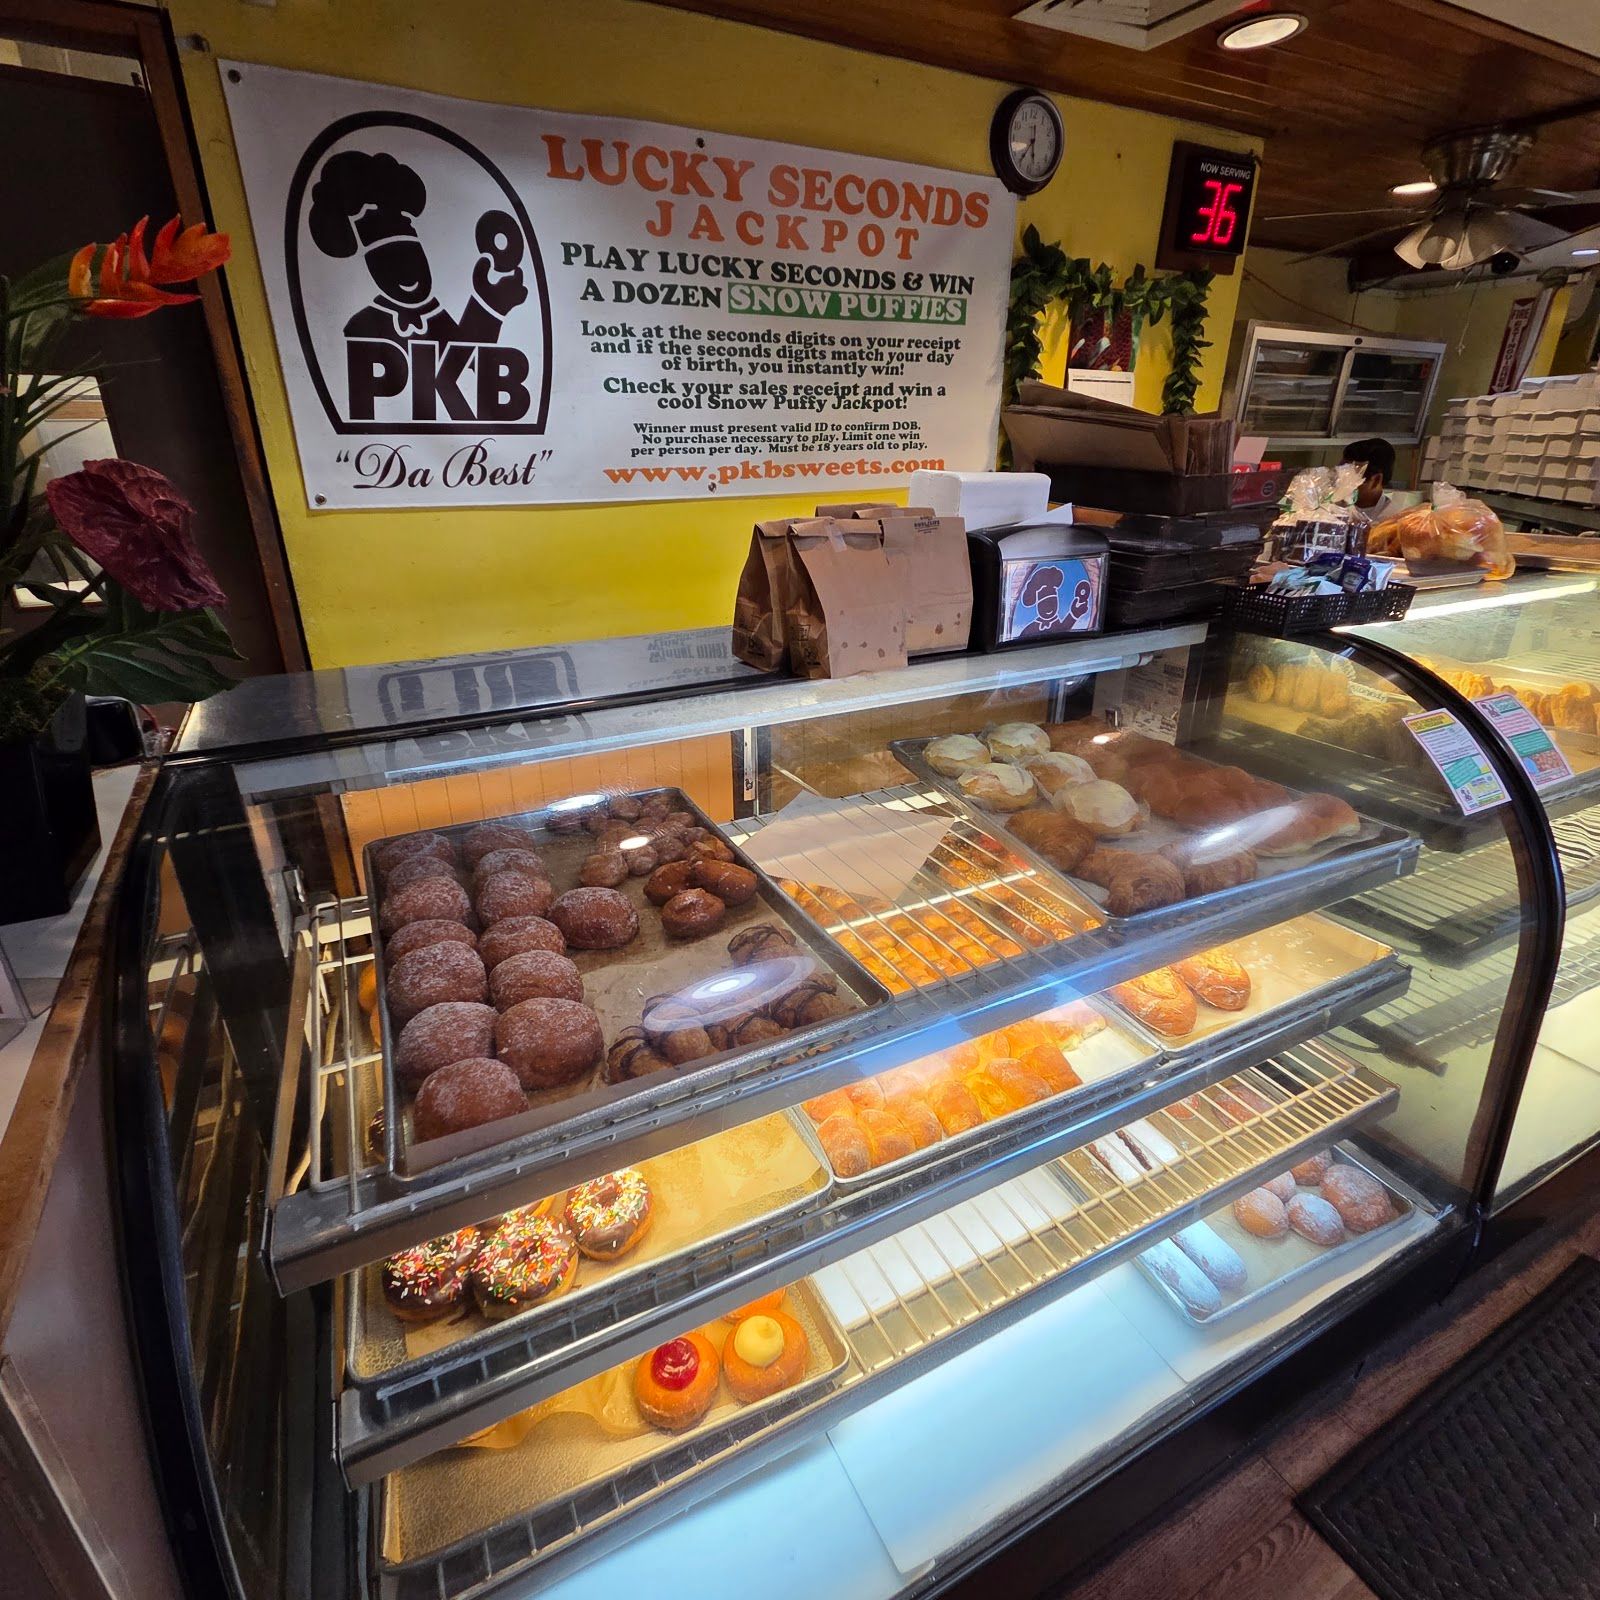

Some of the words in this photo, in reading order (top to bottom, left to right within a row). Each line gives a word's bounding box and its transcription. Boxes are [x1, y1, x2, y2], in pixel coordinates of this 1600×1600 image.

[541, 134, 755, 202] LUCKY
[767, 164, 991, 229] SECONDS
[1200, 162, 1219, 174] NOW
[1219, 166, 1252, 180] SERVING
[1191, 180, 1243, 245] 36
[645, 200, 919, 260] JACKPOT
[560, 242, 649, 272] PLAY
[657, 251, 764, 280] LUCKY
[770, 261, 896, 291] SECONDS
[902, 271, 924, 291] &
[929, 273, 975, 295] WIN
[580, 278, 605, 302] A
[612, 280, 723, 309] DOZEN
[729, 283, 831, 317] SNOW
[838, 293, 963, 323] PUFFIES
[580, 320, 637, 338] Look
[641, 324, 664, 339] at
[669, 324, 702, 340] the
[706, 329, 781, 344] seconds
[785, 330, 836, 349] digits
[840, 336, 862, 347] on
[866, 336, 904, 350] your
[907, 336, 961, 352] receipt
[590, 339, 631, 354] and
[636, 339, 653, 354] if
[658, 340, 692, 355] the
[697, 344, 772, 358] seconds
[776, 345, 827, 362] digits
[831, 348, 884, 362] match
[887, 350, 923, 364] your
[927, 350, 955, 365] day
[661, 356, 682, 371] of
[687, 357, 743, 375] birth,
[748, 363, 783, 376] you
[787, 360, 867, 377] instantly
[871, 361, 905, 376] win!
[345, 340, 531, 422] PKB
[603, 376, 677, 393] Check
[682, 382, 733, 397] your
[739, 380, 788, 396] sales
[793, 382, 860, 399] receipt
[863, 382, 894, 396] and
[898, 382, 936, 396] win
[937, 384, 946, 396] a
[657, 394, 703, 409] cool
[707, 394, 768, 409] Snow
[773, 394, 827, 412] Puffy
[831, 395, 908, 412] Jackpot!
[633, 423, 686, 433] Winner
[690, 423, 724, 433] must
[727, 423, 777, 434] present
[781, 422, 811, 432] valid
[814, 422, 828, 432] ID
[831, 422, 842, 432] to
[844, 421, 890, 431] confirm
[892, 421, 921, 431] DOB.
[642, 434, 662, 444] No
[665, 434, 728, 446] purchase
[731, 434, 794, 445] necessary
[796, 433, 809, 443] to
[812, 432, 839, 444] play.
[842, 432, 873, 441] Limit
[875, 432, 896, 441] one
[898, 431, 920, 440] win
[631, 447, 655, 457] per
[658, 445, 706, 457] person
[709, 445, 732, 456] per
[734, 444, 762, 455] day.
[768, 443, 799, 453] Must
[802, 443, 815, 451] be
[817, 443, 831, 451] 18
[833, 442, 864, 452] years
[866, 441, 885, 450] old
[887, 441, 899, 450] to
[902, 440, 928, 451] play.
[603, 458, 945, 484] www.pkbsweets.com
